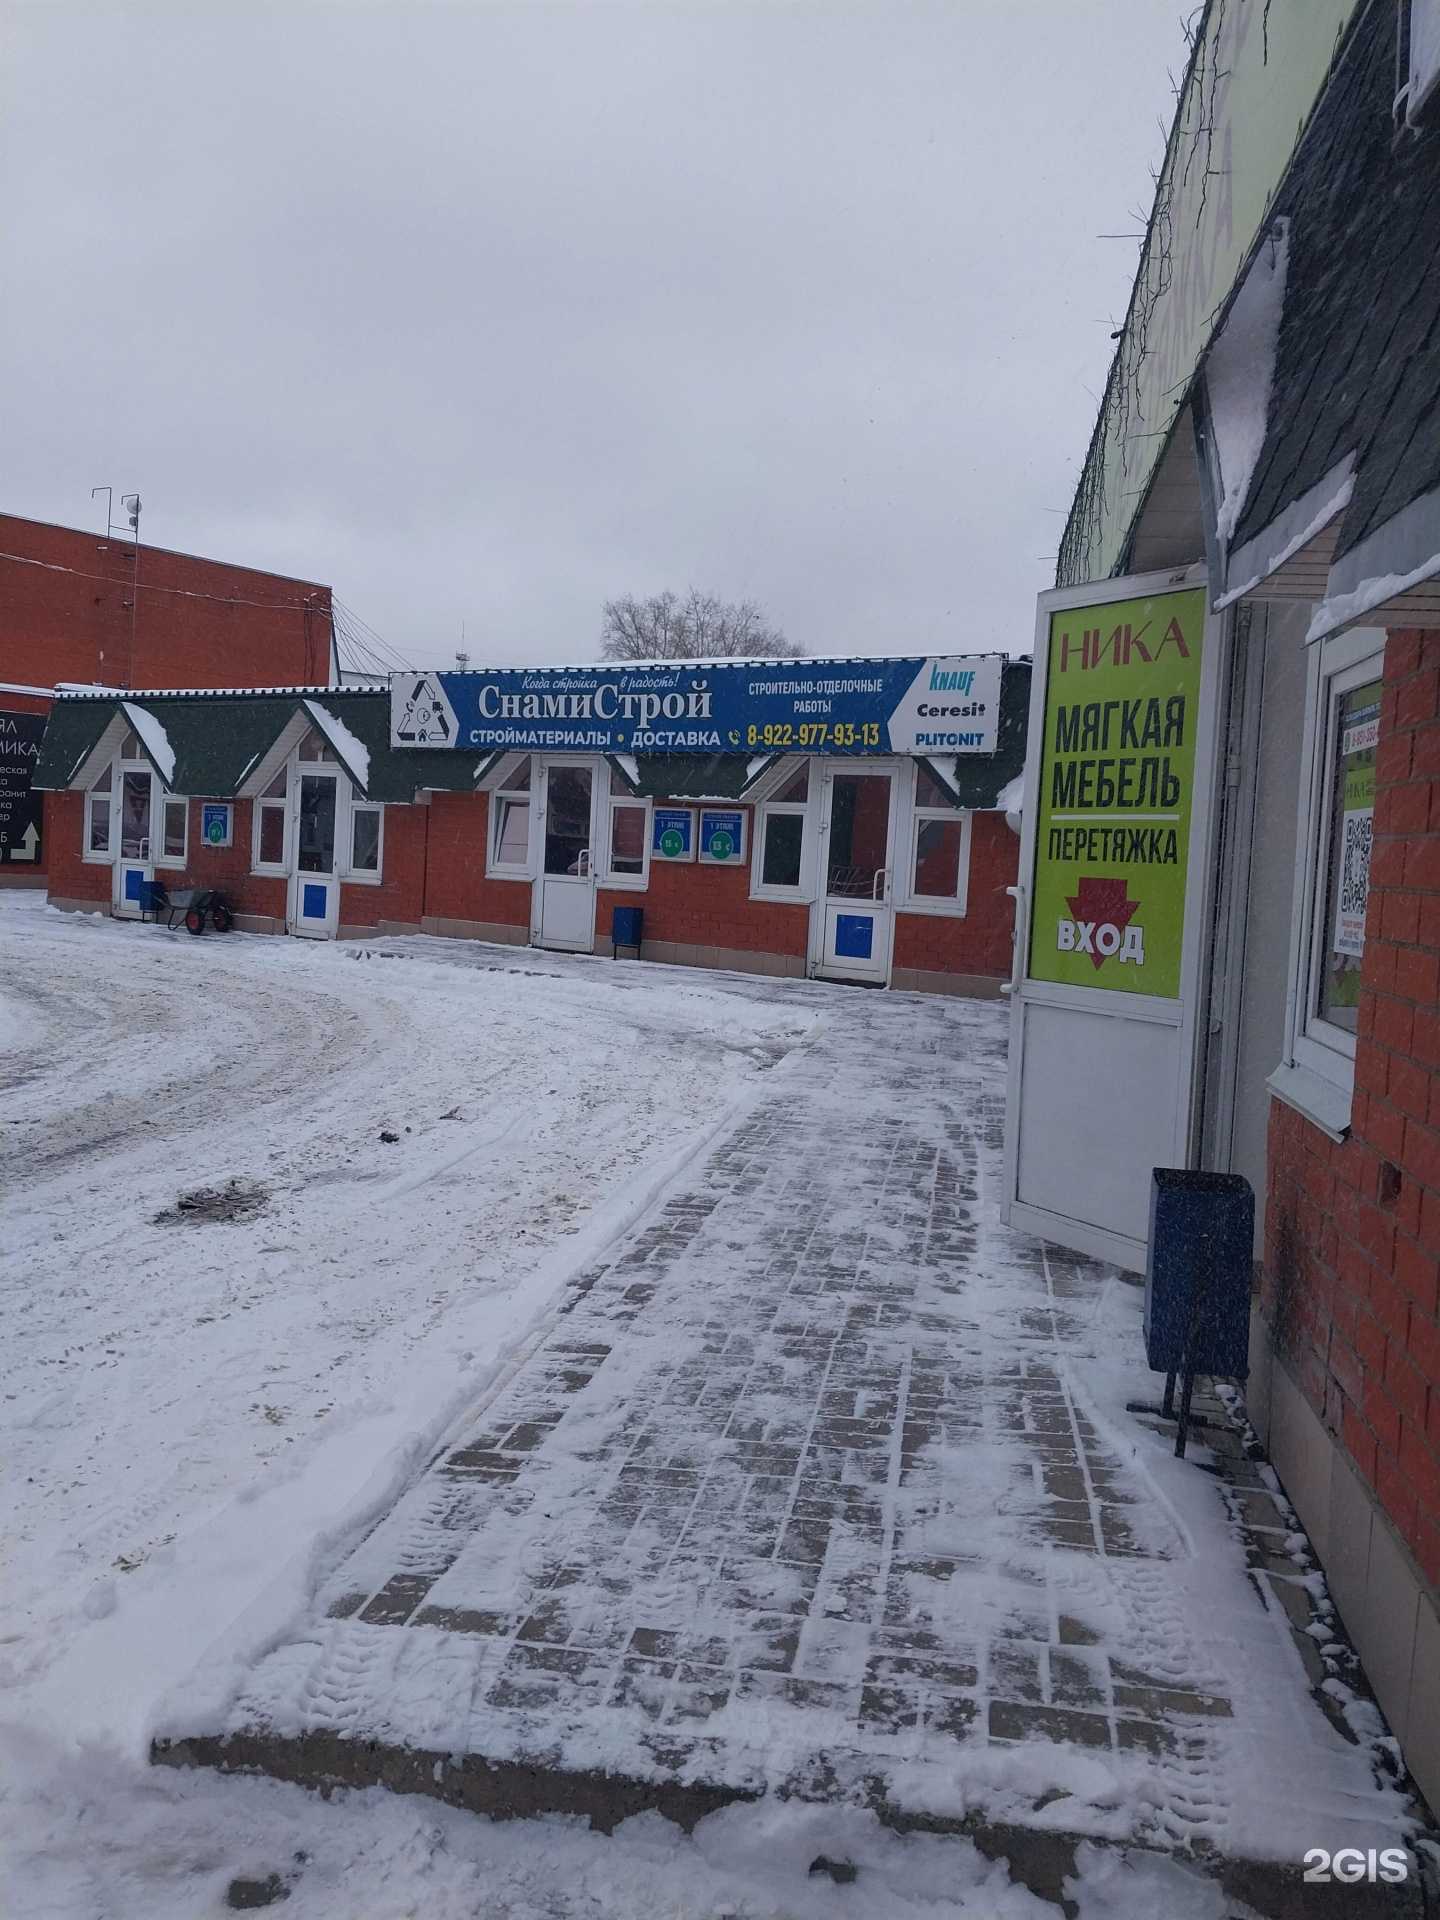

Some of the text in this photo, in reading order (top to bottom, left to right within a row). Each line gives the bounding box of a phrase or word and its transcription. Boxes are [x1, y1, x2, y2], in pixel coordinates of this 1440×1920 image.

[1059, 616, 1191, 673] НИКА
[521, 675, 551, 690] Когда
[552, 675, 598, 692] стройка
[620, 675, 627, 689] в
[748, 679, 883, 696] СТРОИТЕЛЬНО-ОТДЕЛОЧНЫЕ
[478, 680, 713, 729] СнамиСтрой
[793, 700, 832, 714] РАБОТЫ
[917, 702, 986, 717] Ceresit
[747, 722, 880, 746] 8-922-977-93-13
[1055, 695, 1186, 753] МЯГКАЯ
[470, 727, 721, 748] СТРОЙМАТЕРИАЛЫ ДОСТАВКА
[915, 732, 985, 746] PLITONIT
[1051, 757, 1181, 809] МЕБЕЛЬ
[1048, 827, 1178, 865] ПЕРЕТЯЖКА
[1056, 918, 1145, 967] ВХОД
